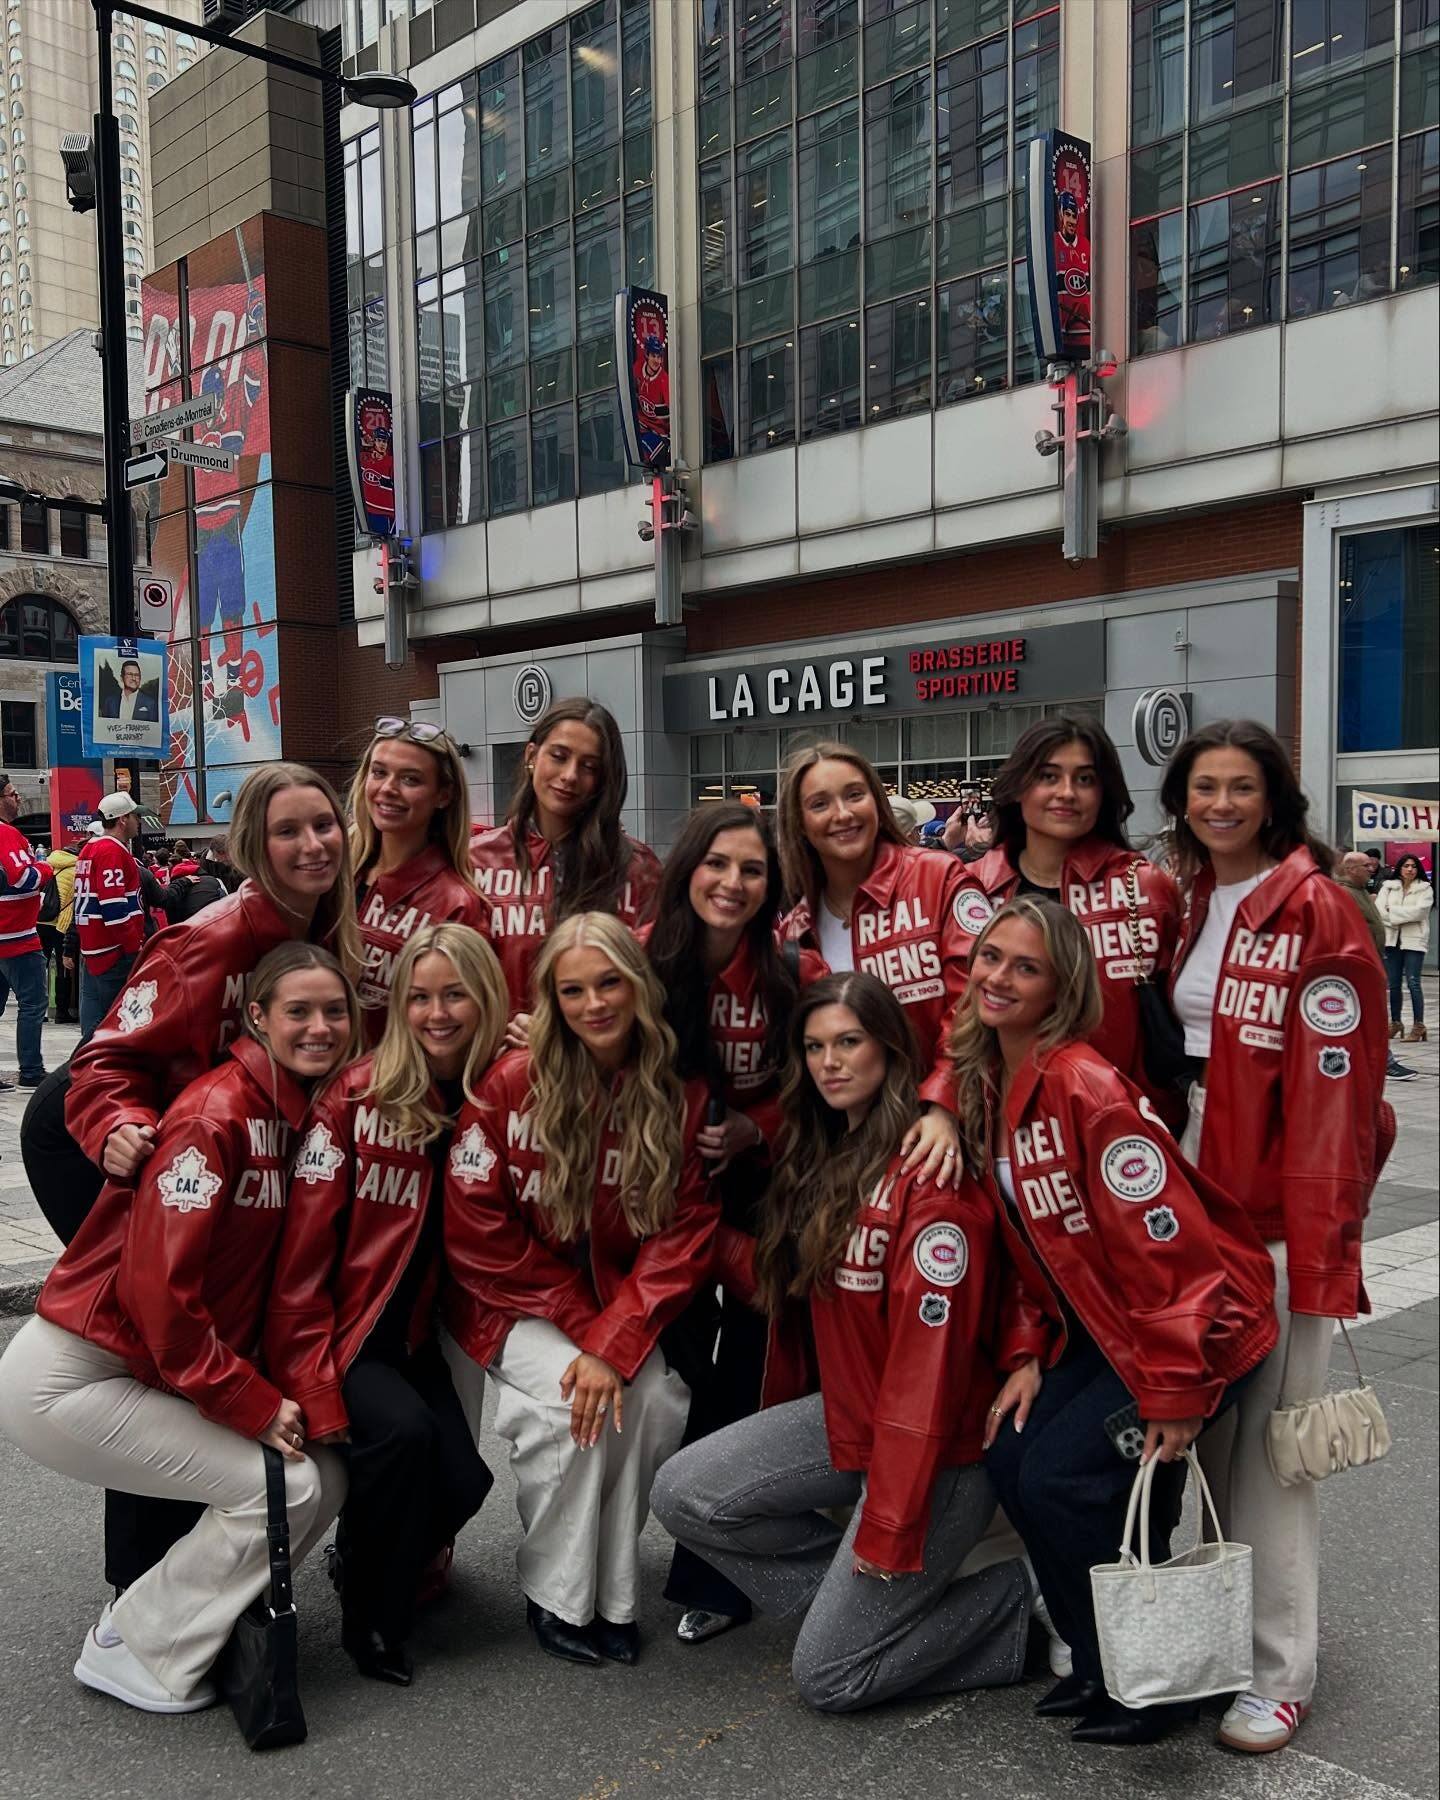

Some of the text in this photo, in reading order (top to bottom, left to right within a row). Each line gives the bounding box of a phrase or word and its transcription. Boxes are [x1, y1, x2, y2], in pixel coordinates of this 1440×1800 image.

[1062, 168, 1082, 197] 14
[144, 402, 212, 437] Canadiens-de-Montréal
[171, 447, 229, 469] Drummond
[909, 638, 1025, 673] BRASSERIE
[708, 656, 886, 720] LA CAGE
[915, 669, 1018, 700] SPORTIVE
[9, 849, 31, 868] 14
[103, 868, 125, 887] 22
[1068, 874, 1150, 915] REAL
[858, 896, 930, 946] REAL
[1083, 917, 1159, 959] IENS
[1228, 927, 1303, 973] REAL
[860, 940, 942, 986] DIENS
[1217, 976, 1290, 1026] DIEN
[305, 1151, 325, 1167] CAC
[462, 1150, 482, 1168] CAC
[1107, 1142, 1149, 1167] MONTREAL
[175, 1177, 200, 1195] CAC
